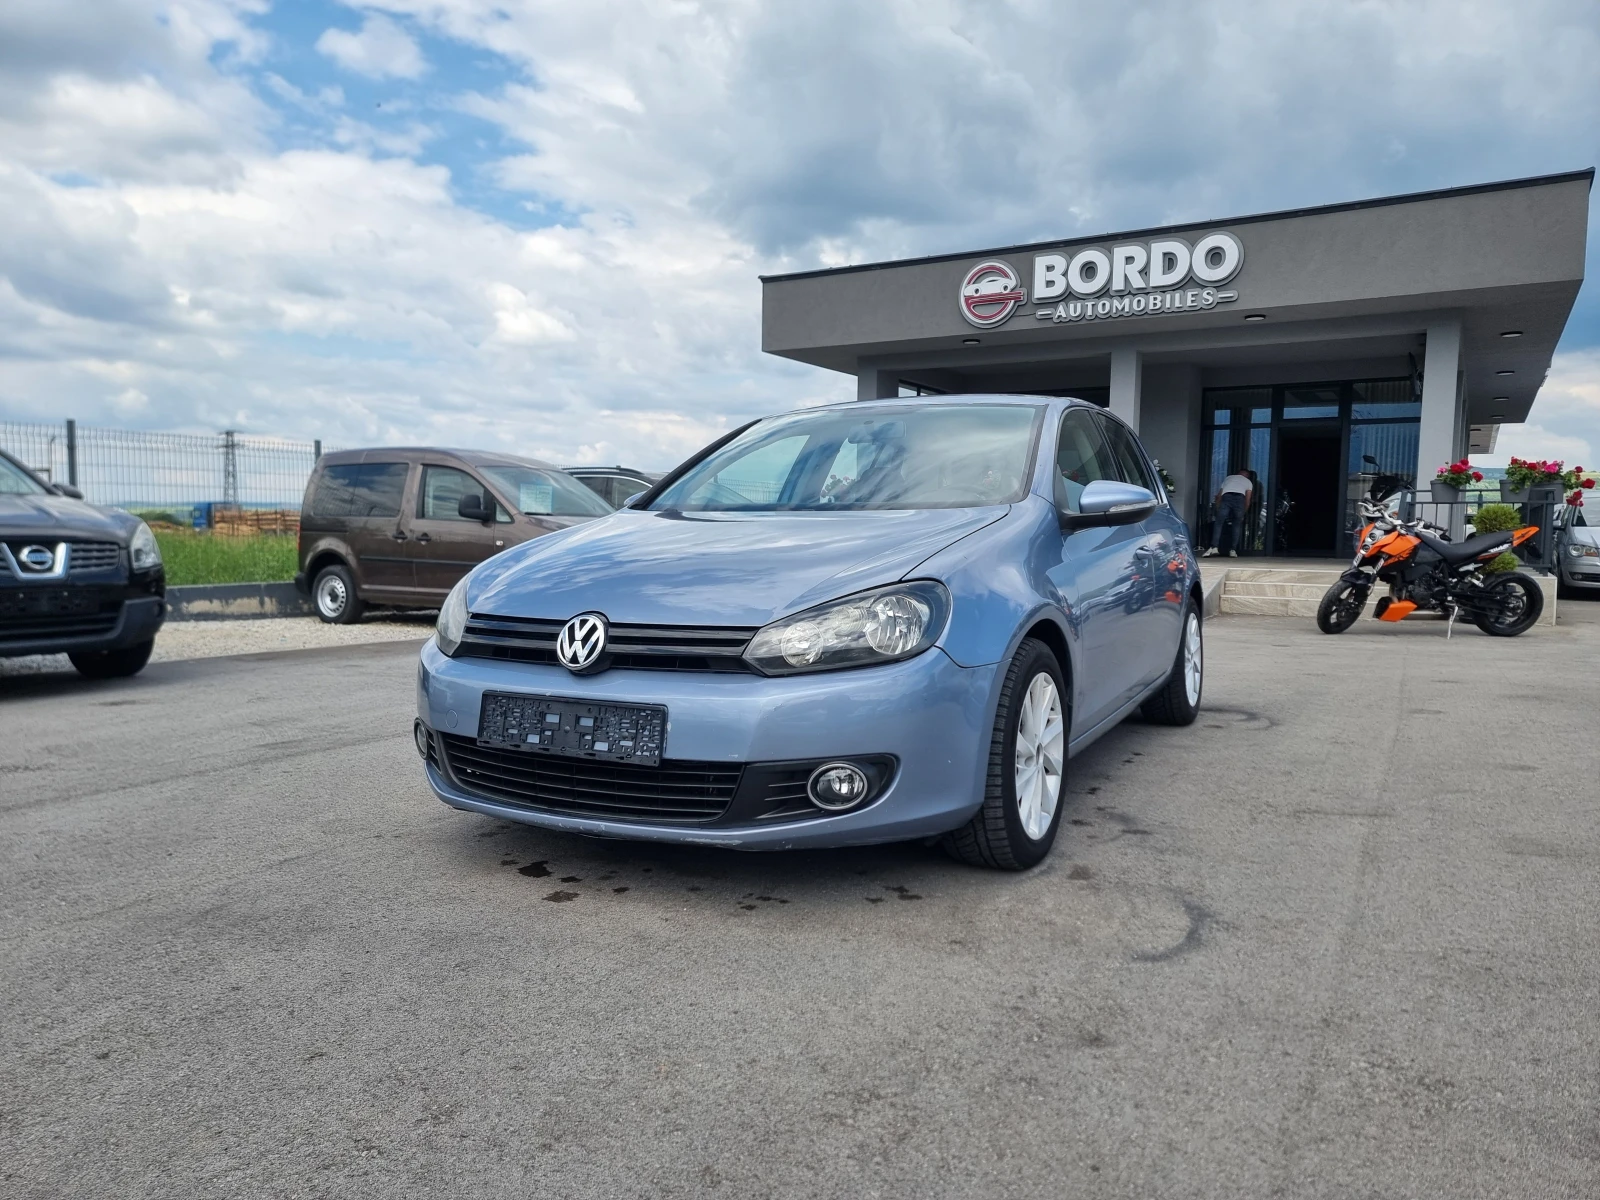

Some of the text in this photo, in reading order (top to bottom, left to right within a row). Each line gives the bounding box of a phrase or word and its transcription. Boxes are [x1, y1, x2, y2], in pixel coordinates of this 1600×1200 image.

[1033, 234, 1240, 300] BORDO
[1054, 290, 1214, 319] AUTOMOBILES
[558, 615, 604, 669] VW
